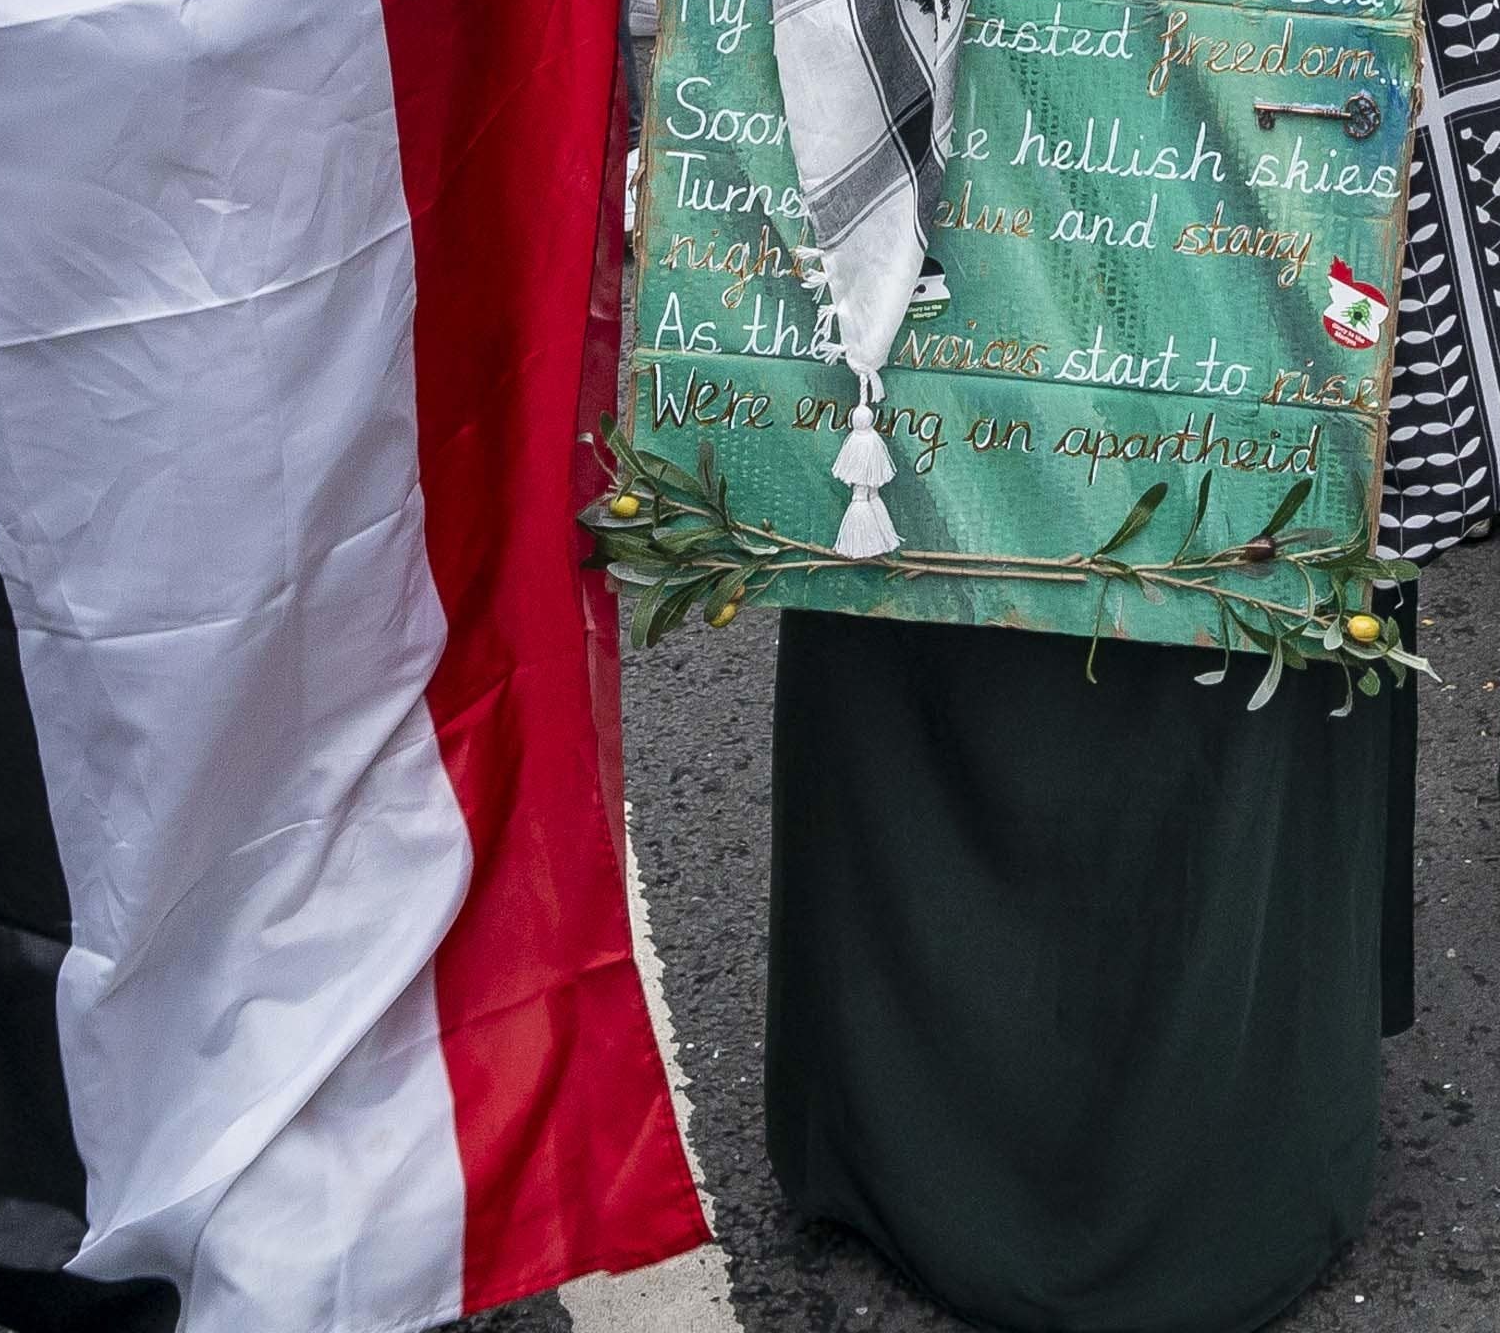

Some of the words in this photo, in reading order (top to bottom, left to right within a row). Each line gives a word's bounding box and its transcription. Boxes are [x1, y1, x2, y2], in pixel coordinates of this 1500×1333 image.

[665, 150, 806, 219] Turne
[1050, 194, 1157, 250] and
[1009, 109, 1228, 185] hellish
[1243, 134, 1404, 200] skies
[654, 291, 723, 354] As
[894, 319, 1051, 377] voices
[1054, 324, 1182, 393] start
[1194, 336, 1254, 397] to
[1261, 358, 1381, 412] rise
[651, 363, 775, 432] We're
[964, 416, 1036, 455] an
[1052, 411, 1320, 488] apartheid
